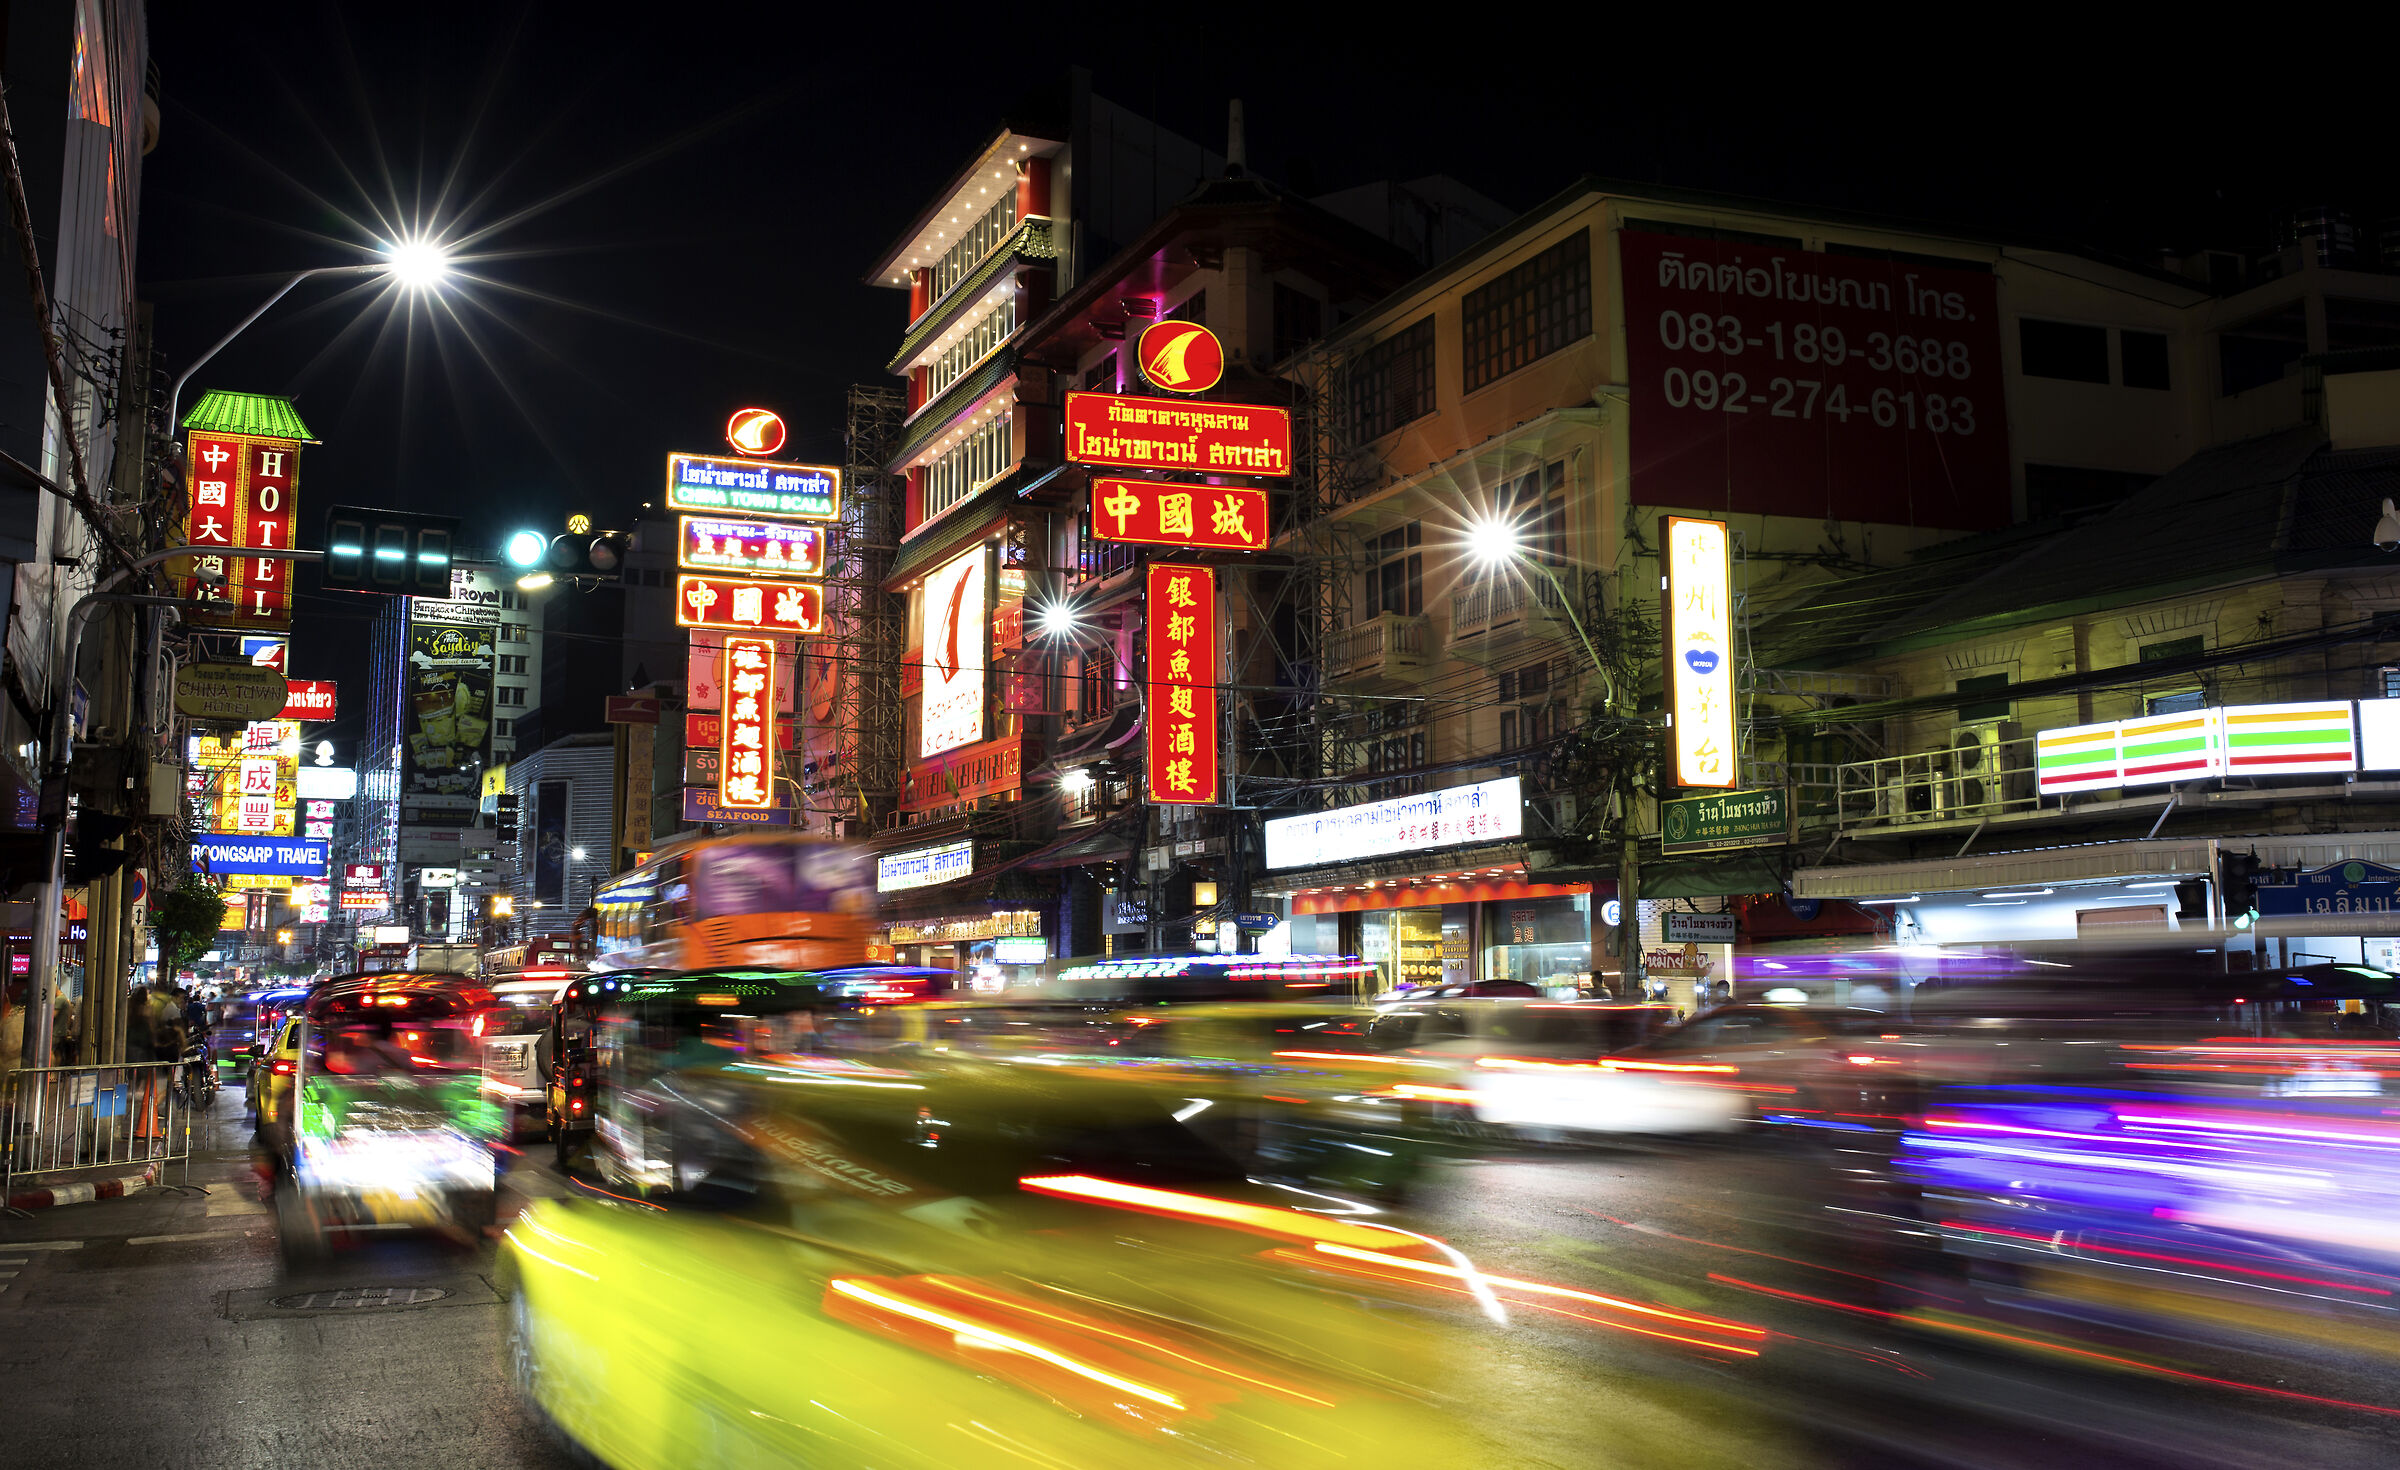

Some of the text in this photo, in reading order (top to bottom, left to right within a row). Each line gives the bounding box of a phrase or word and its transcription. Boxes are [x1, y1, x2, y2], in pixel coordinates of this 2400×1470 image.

[1658, 251, 1976, 323] ติดต่อโฆษณา โทร.
[1659, 309, 1972, 381] 083-189-3688
[1663, 367, 1976, 436] 092-274-6183
[1074, 421, 1283, 468] ไชน่าทาวน์ สกาล่า
[730, 491, 778, 509] TOWN
[780, 495, 832, 514] SCALA
[1103, 484, 1252, 544] 中國城
[253, 451, 285, 617] HOTEL
[459, 587, 500, 604] Royal
[685, 580, 810, 630] 中國城
[177, 681, 282, 701] CHINA TOWN
[1164, 575, 1199, 795] 銀都魚翅酒樓
[203, 702, 253, 714] HOTEL
[926, 721, 978, 753] SCALA
[706, 810, 770, 821] SEAFOOD
[276, 847, 324, 865] TRAVEL
[2312, 874, 2331, 884] แยก
[1267, 916, 1274, 925] 2
